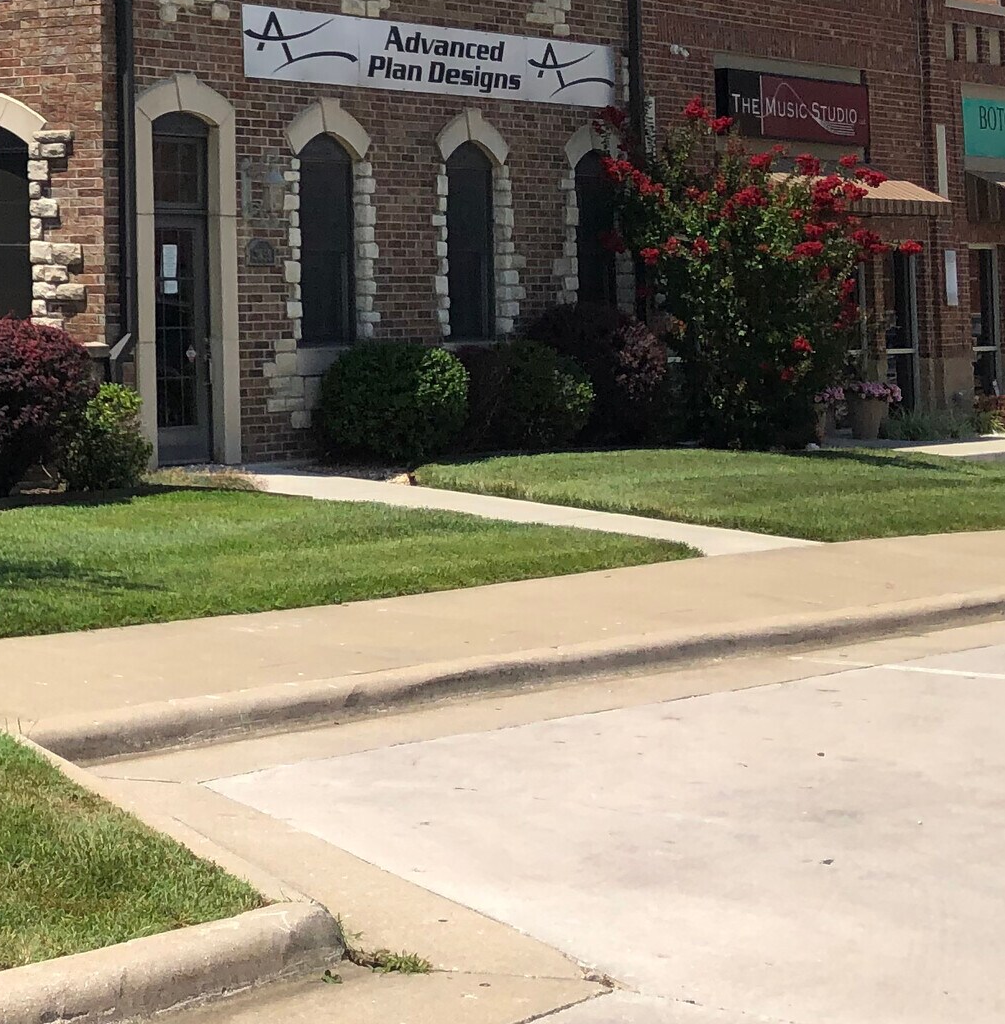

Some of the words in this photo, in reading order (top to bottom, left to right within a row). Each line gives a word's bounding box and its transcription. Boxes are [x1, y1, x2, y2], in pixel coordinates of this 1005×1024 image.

[384, 26, 505, 62] Advanced
[367, 55, 423, 83] Plan
[428, 61, 522, 94] Designs
[731, 93, 760, 115] THE
[765, 96, 808, 119] MUSIC
[811, 102, 858, 125] STUDIO
